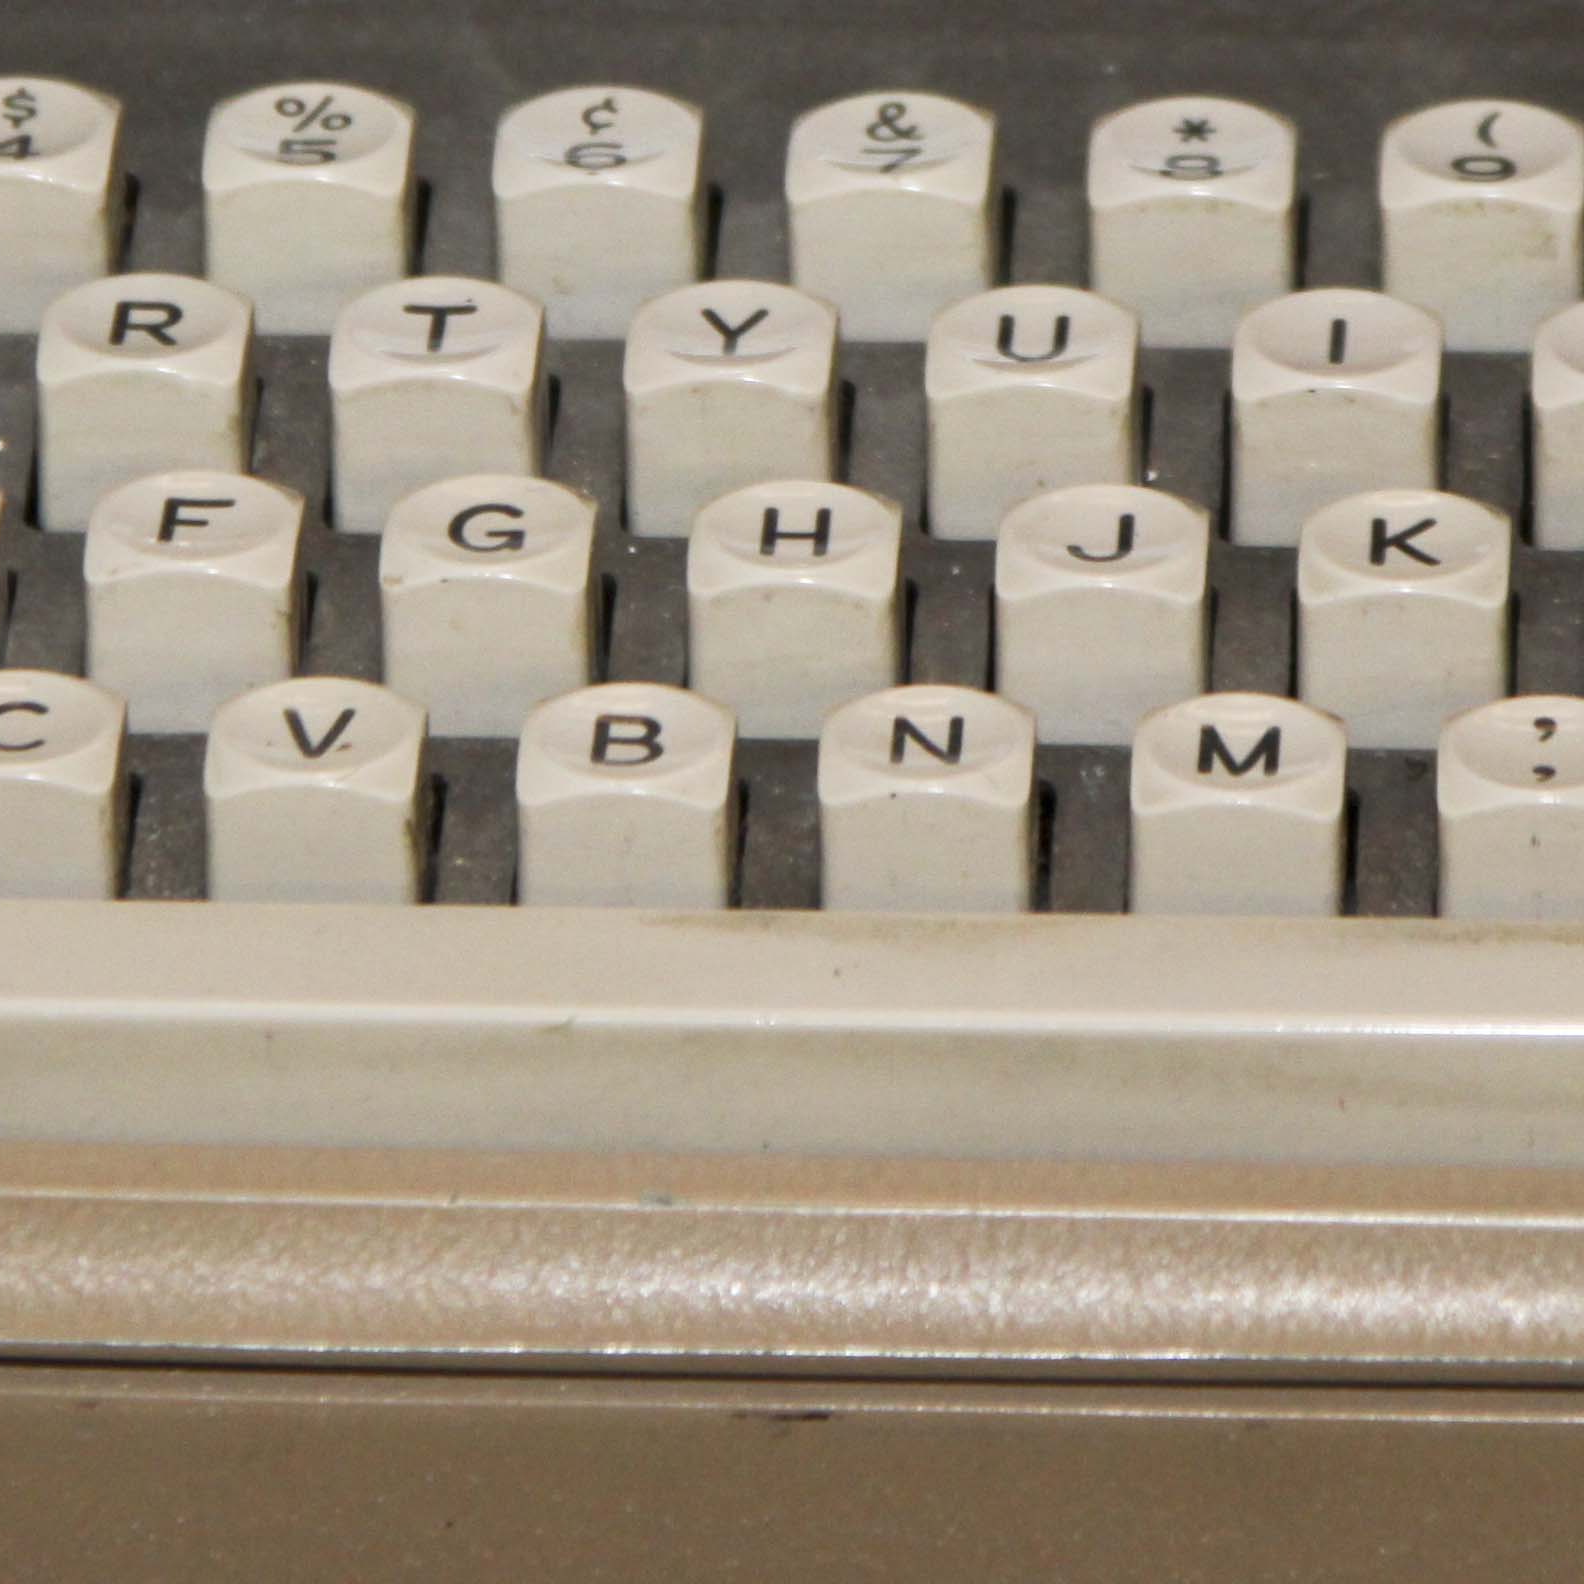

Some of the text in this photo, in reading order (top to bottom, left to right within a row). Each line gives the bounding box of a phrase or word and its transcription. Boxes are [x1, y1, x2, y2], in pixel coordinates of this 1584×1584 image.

[1, 87, 38, 130] $
[273, 95, 353, 133] %
[865, 101, 922, 143] &
[279, 139, 337, 164] 5
[107, 301, 183, 348] R
[402, 304, 477, 353] T
[700, 308, 769, 355] Y
[996, 314, 1070, 363] U
[1327, 318, 1347, 366] I
[156, 497, 235, 543] F
[446, 503, 525, 553] G
[759, 507, 831, 558] H
[1066, 514, 1135, 563] J
[1368, 518, 1441, 568] K
[282, 708, 356, 760] V
[589, 714, 664, 767] B
[889, 716, 964, 766] N
[1196, 725, 1281, 778] M
